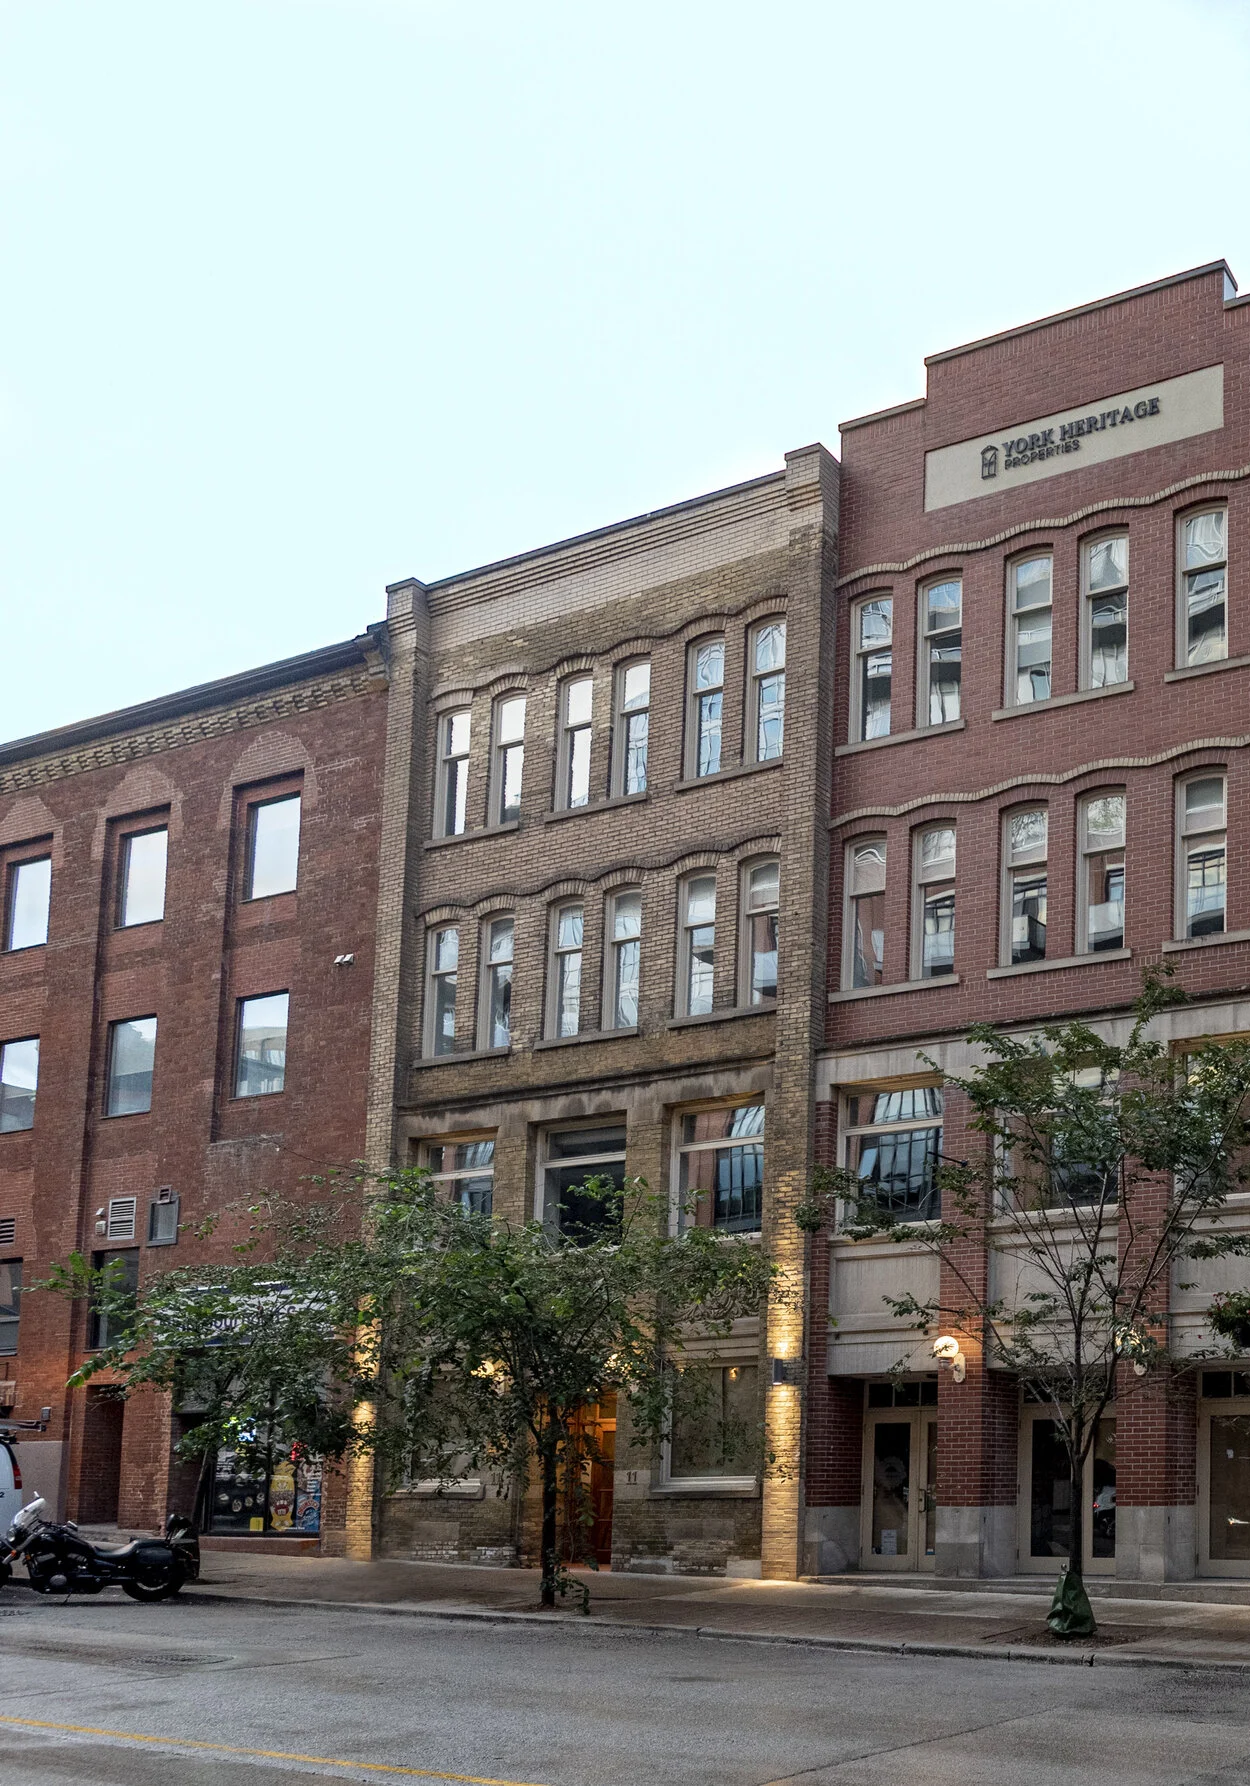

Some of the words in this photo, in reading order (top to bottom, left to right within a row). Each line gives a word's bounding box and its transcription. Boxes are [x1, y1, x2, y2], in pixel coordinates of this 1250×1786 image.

[1001, 427, 1056, 458] YORK
[1059, 397, 1160, 441] HERITAGE
[1004, 439, 1080, 470] PROPERTIES
[626, 1471, 638, 1485] 11
